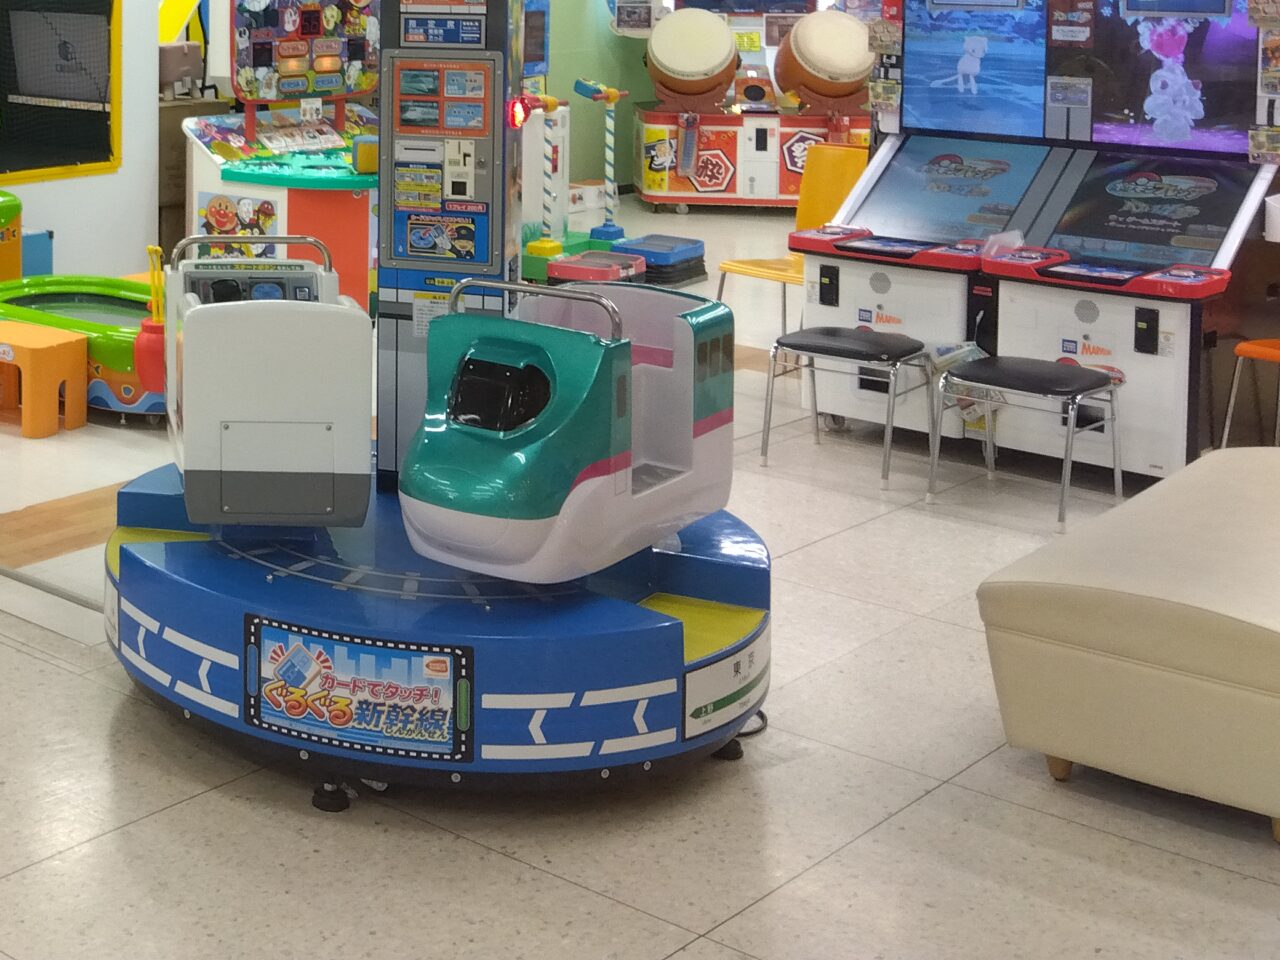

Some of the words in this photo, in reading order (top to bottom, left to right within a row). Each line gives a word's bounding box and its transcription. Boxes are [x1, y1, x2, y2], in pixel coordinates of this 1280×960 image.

[262, 679, 355, 728] ぐるぐる
[353, 699, 449, 732] 新幹線
[320, 673, 441, 705] カードでタッチ!
